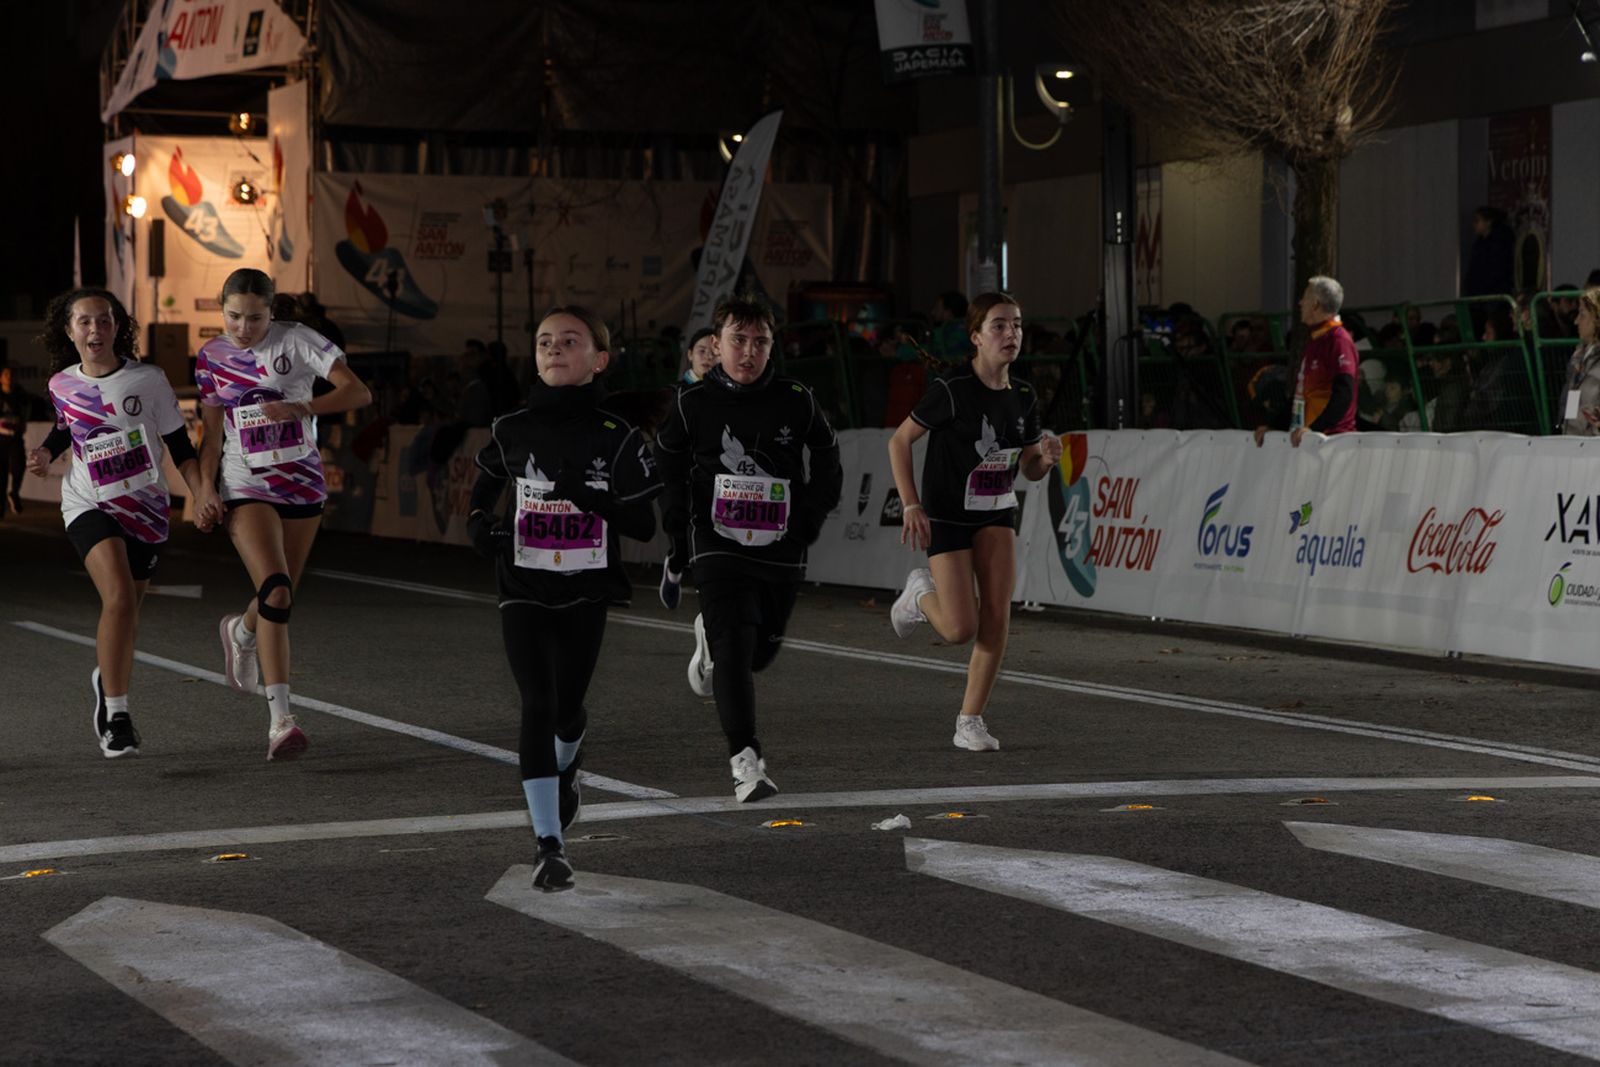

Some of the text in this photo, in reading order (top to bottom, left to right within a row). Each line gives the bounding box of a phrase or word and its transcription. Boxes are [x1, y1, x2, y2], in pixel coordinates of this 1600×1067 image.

[893, 47, 964, 62] DACIA
[894, 57, 966, 73] JAPEMASA
[184, 208, 220, 243] 43
[524, 500, 538, 512] SAN
[722, 490, 738, 500] SAN
[1093, 476, 1140, 519] SAN
[523, 512, 596, 542] 15462
[1058, 494, 1090, 560] 43
[1083, 515, 1161, 571] ANTÓN
[1296, 525, 1365, 576] aqualia
